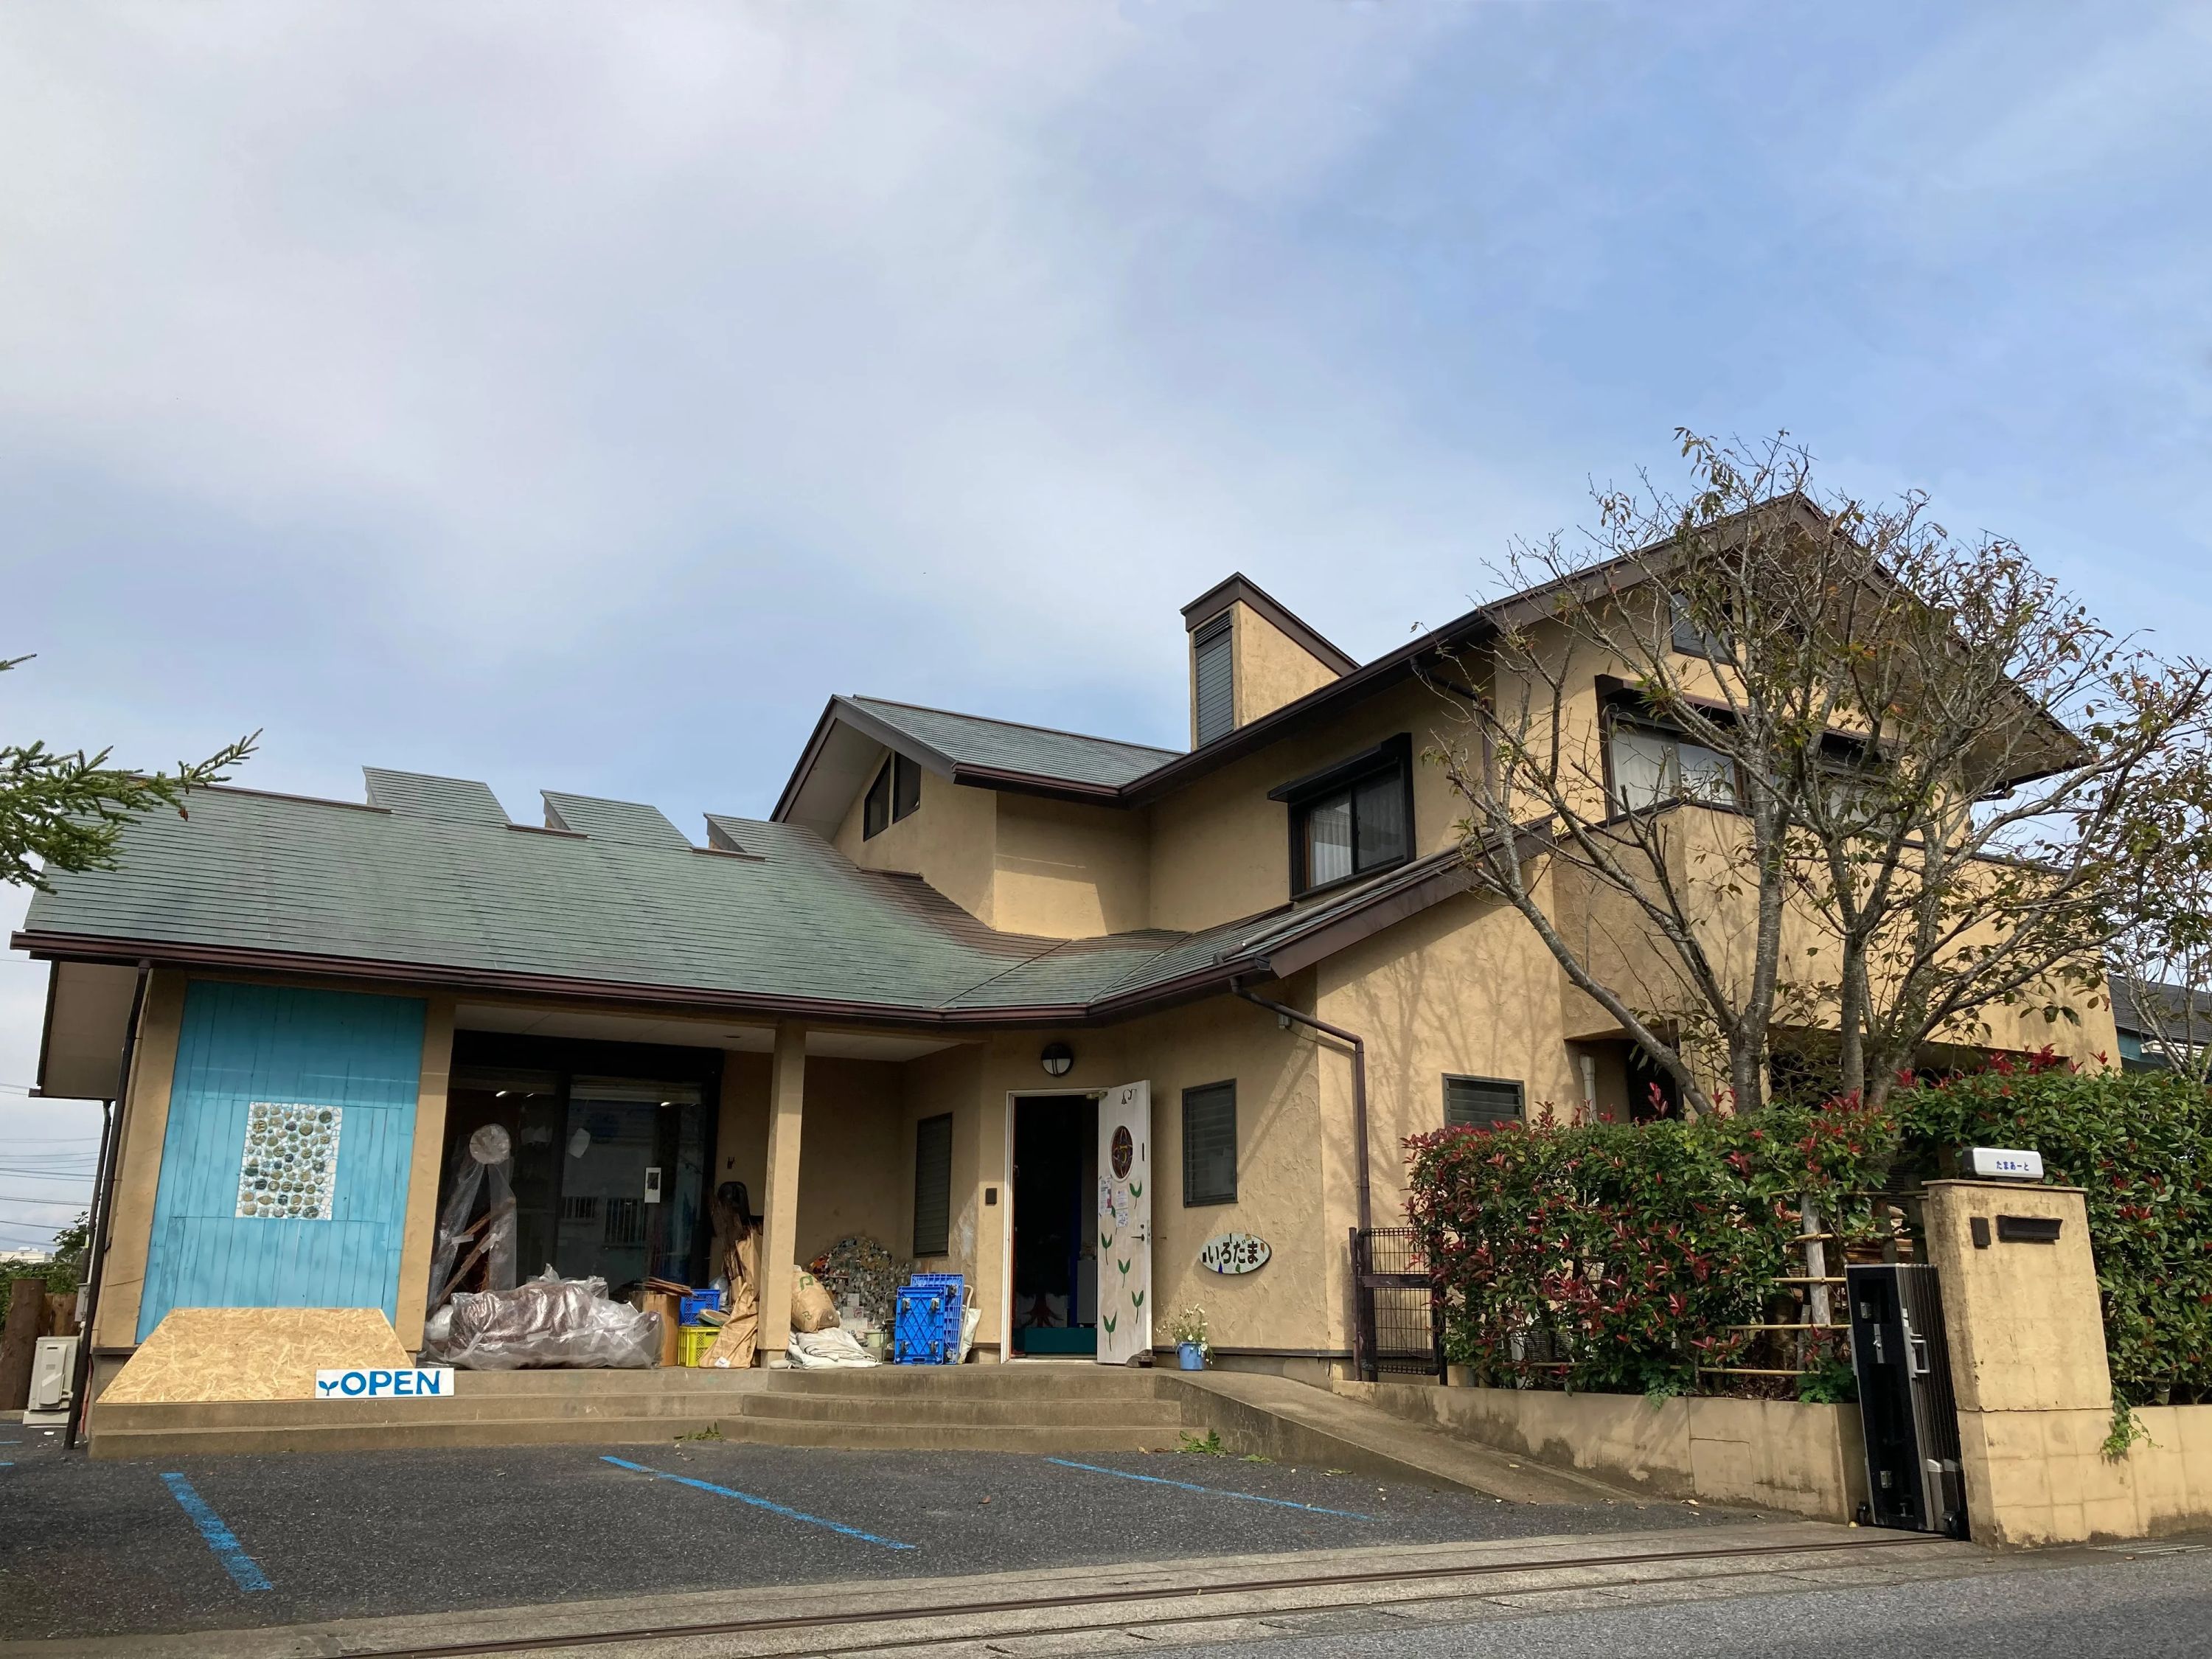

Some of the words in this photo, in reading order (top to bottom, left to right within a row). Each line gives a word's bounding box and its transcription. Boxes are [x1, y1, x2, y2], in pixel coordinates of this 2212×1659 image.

[1996, 1161, 2029, 1171] たまあーと
[1208, 1239, 1259, 1265] いろだま
[341, 1371, 440, 1396] OPEN
